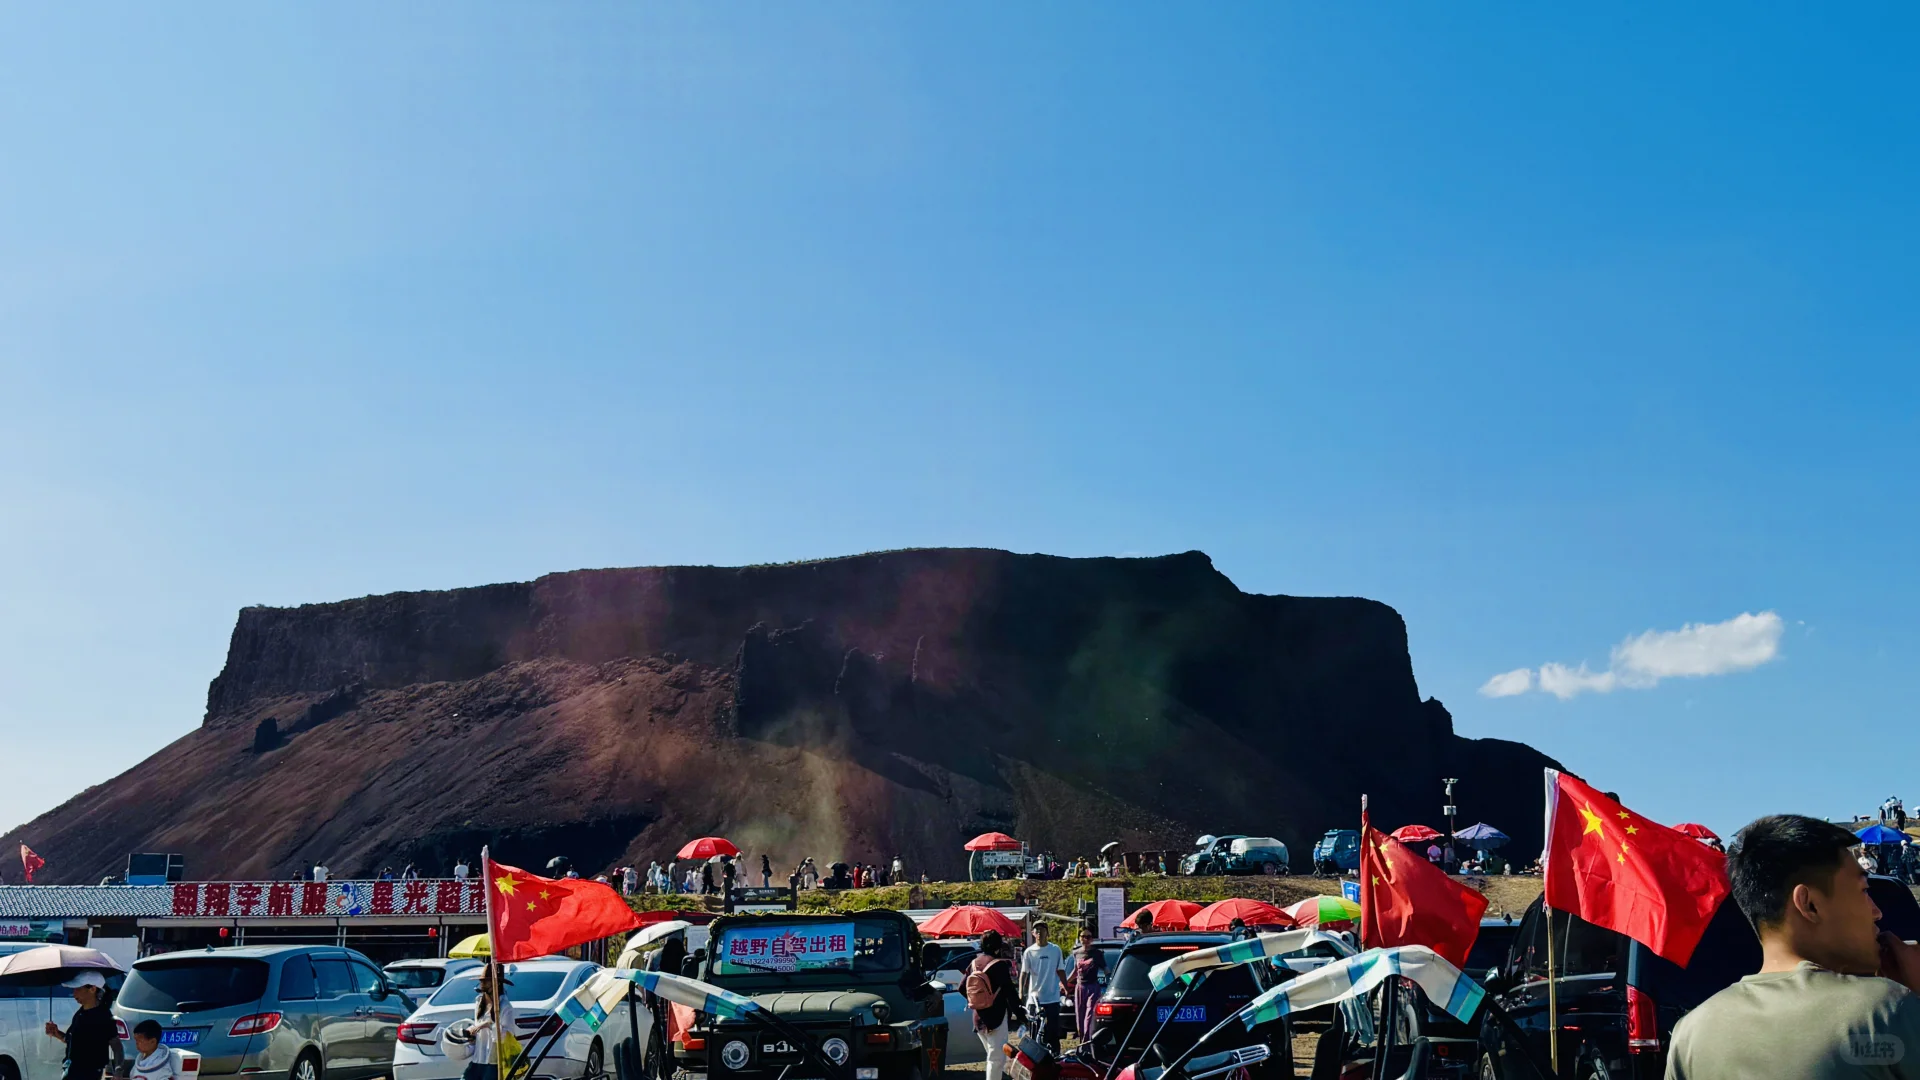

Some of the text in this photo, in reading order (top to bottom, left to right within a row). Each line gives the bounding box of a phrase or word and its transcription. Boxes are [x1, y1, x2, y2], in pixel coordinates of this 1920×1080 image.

[729, 934, 847, 957] 越野自驾出租
